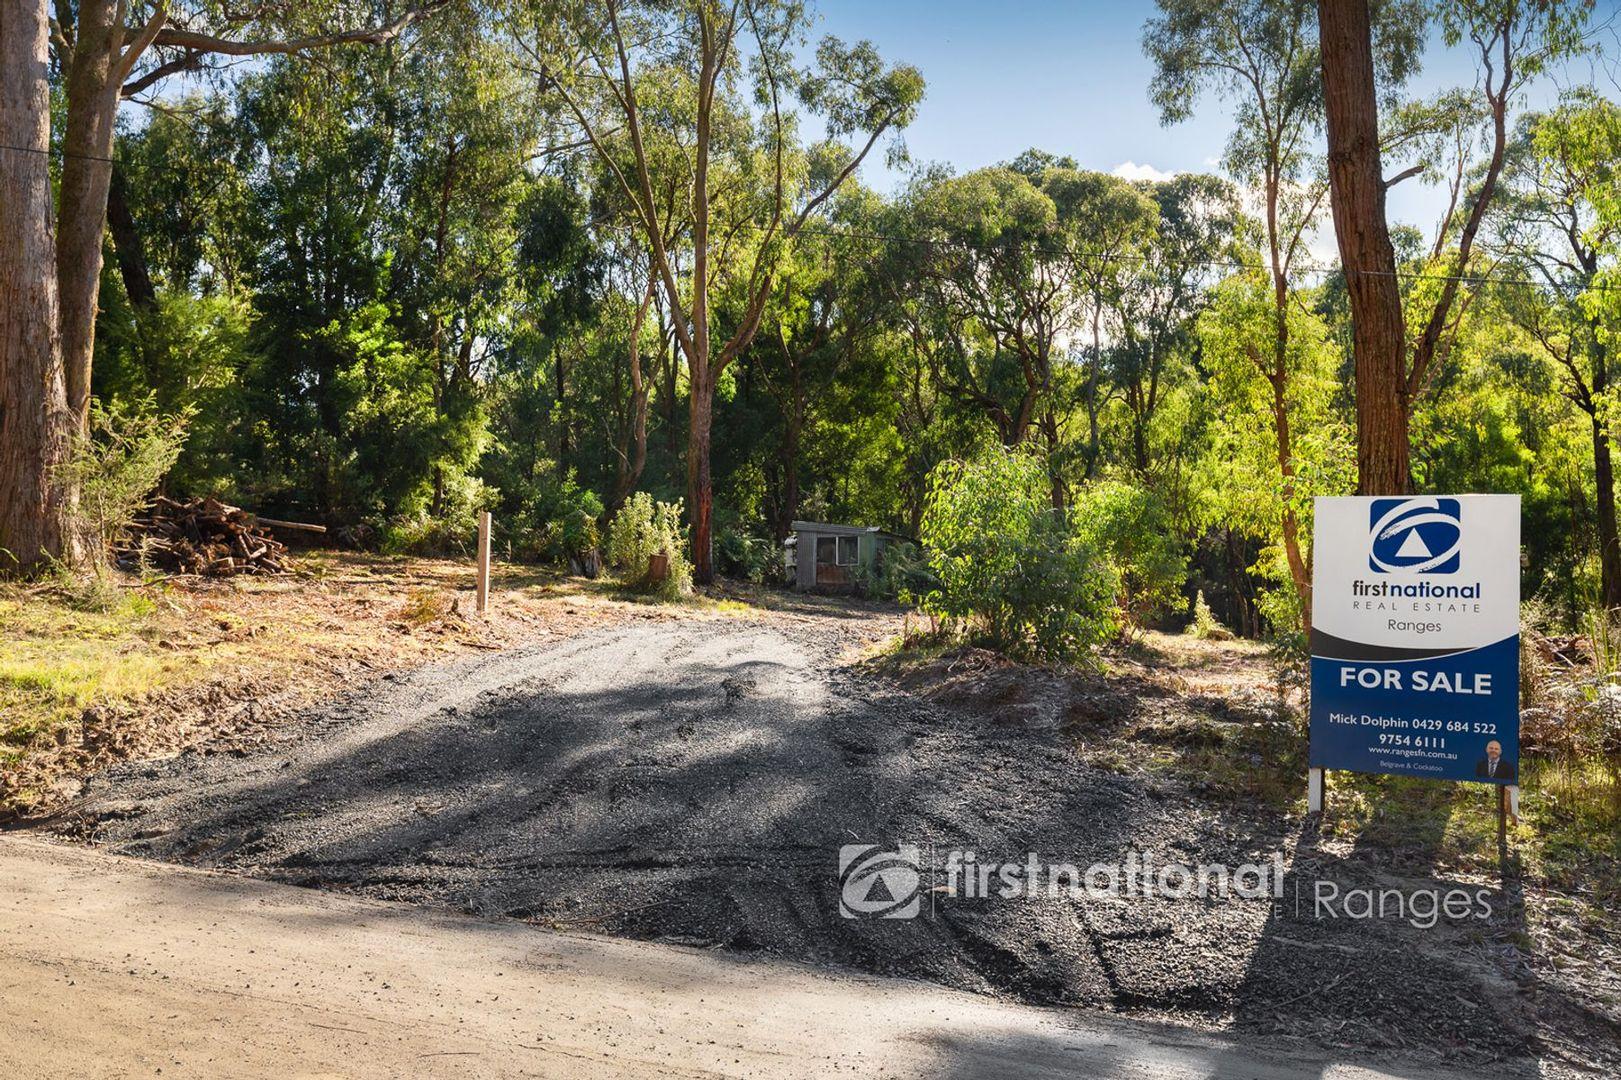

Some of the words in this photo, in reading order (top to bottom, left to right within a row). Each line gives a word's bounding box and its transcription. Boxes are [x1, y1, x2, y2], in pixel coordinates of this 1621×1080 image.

[1353, 580, 1481, 599] firstnational
[1353, 600, 1398, 611] REAL
[1413, 602, 1481, 613] ESTATE
[1388, 619, 1442, 634] Ranges
[1340, 667, 1403, 690] FOR
[1412, 670, 1492, 695] SALE
[1329, 713, 1357, 726] Mick
[1361, 715, 1409, 729] Dolphin
[1412, 718, 1443, 730] 0429
[1446, 721, 1470, 732] 684
[1473, 723, 1497, 734] 522
[1379, 733, 1411, 746] 9754
[1414, 736, 1446, 748] 6111
[1368, 746, 1458, 760] www.rangesfn.com.au
